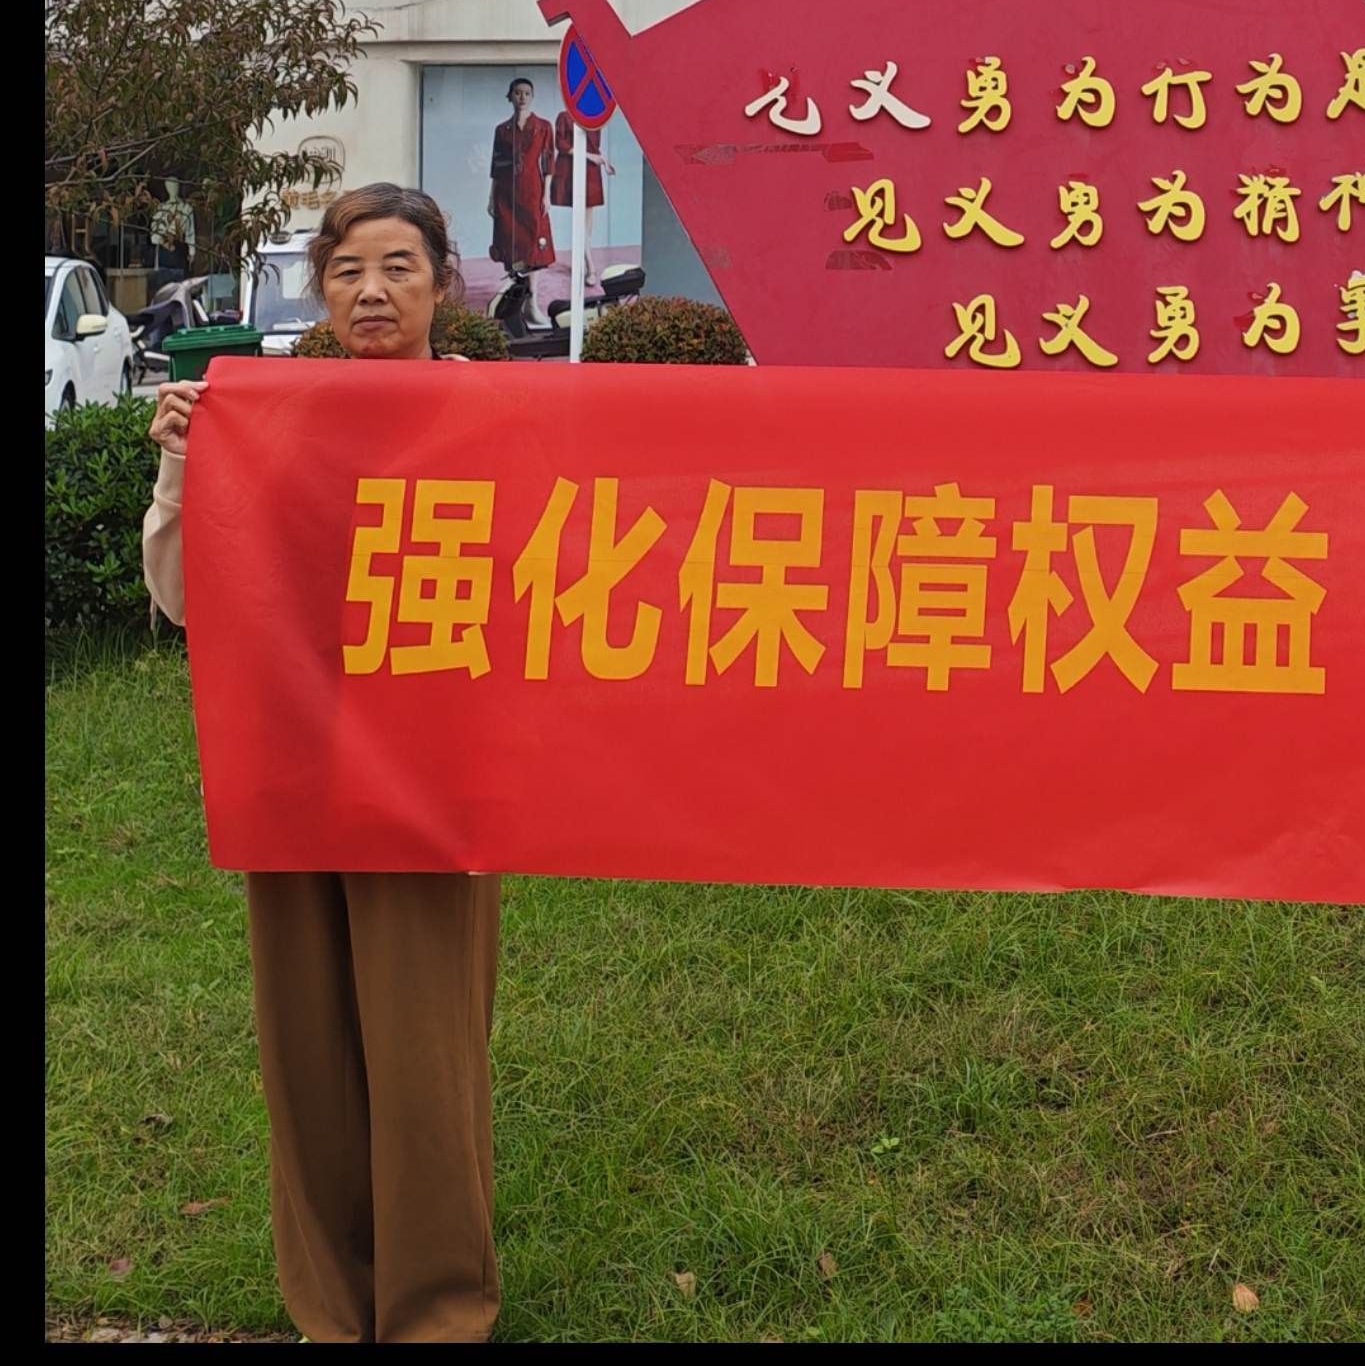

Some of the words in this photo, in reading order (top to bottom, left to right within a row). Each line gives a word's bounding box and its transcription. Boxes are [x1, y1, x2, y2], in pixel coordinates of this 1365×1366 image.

[342, 475, 1329, 696] 强化保障权益
